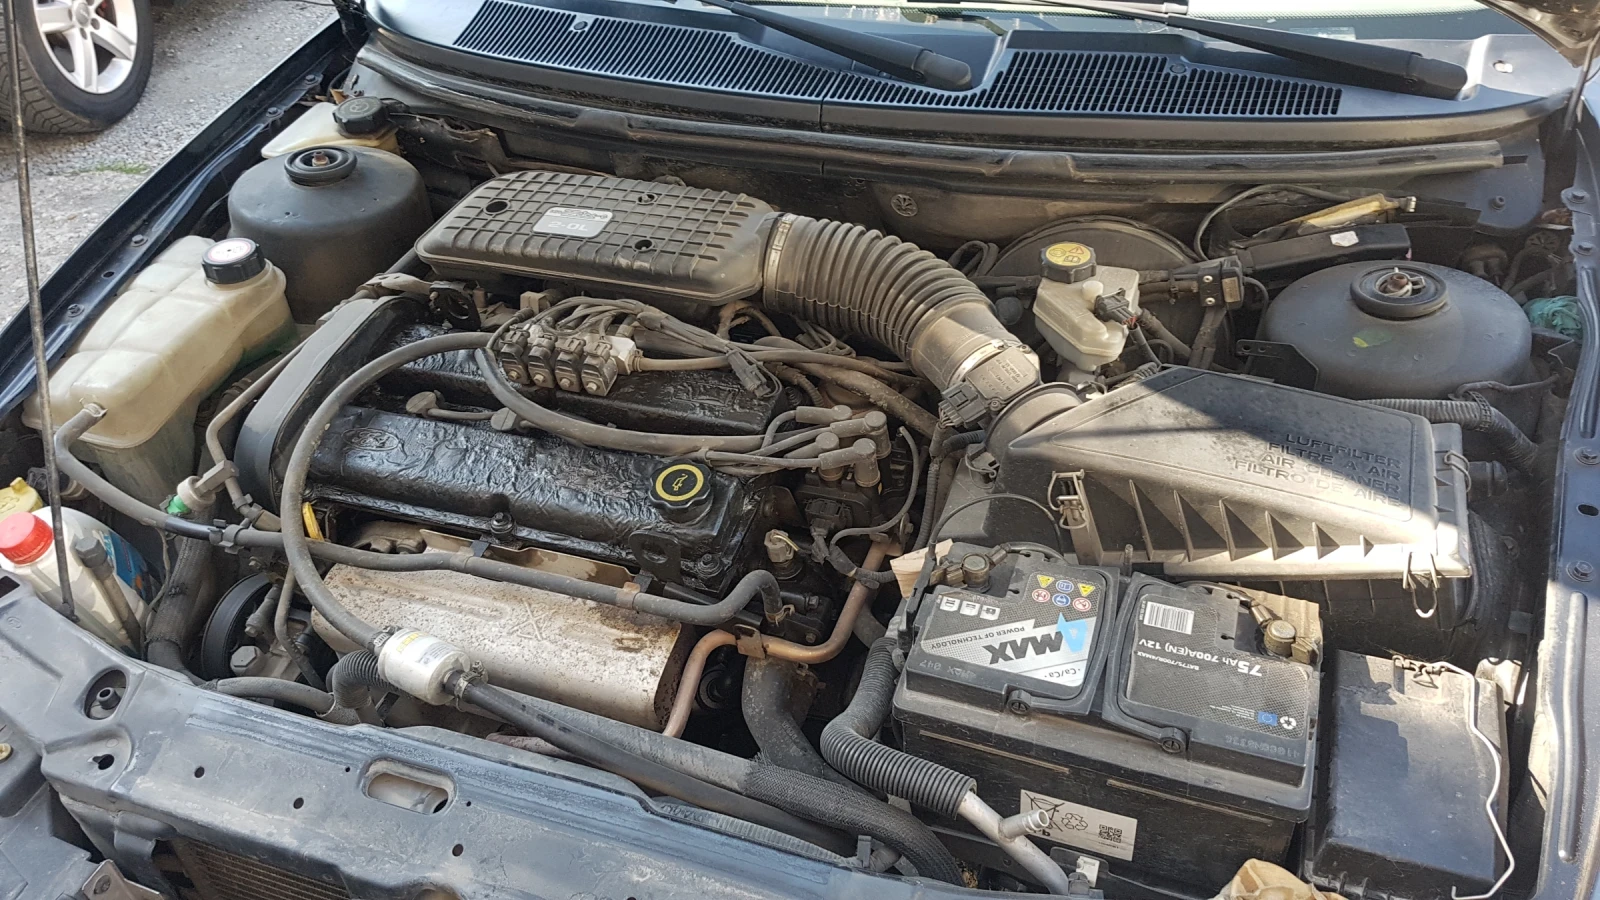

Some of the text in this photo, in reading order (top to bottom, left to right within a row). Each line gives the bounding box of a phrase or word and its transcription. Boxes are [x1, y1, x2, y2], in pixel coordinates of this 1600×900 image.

[1268, 442, 1402, 481] FILTRE A AIR
[1286, 433, 1402, 469] LUFTFILTER
[1234, 459, 1402, 507] FILTRO DE AIRE
[1260, 452, 1402, 494] AIR CLEANER
[931, 634, 984, 650] TECHNOLOGY
[999, 626, 1025, 637] POWER
[1139, 638, 1263, 677] 75Ah 700A(EN) 12V
